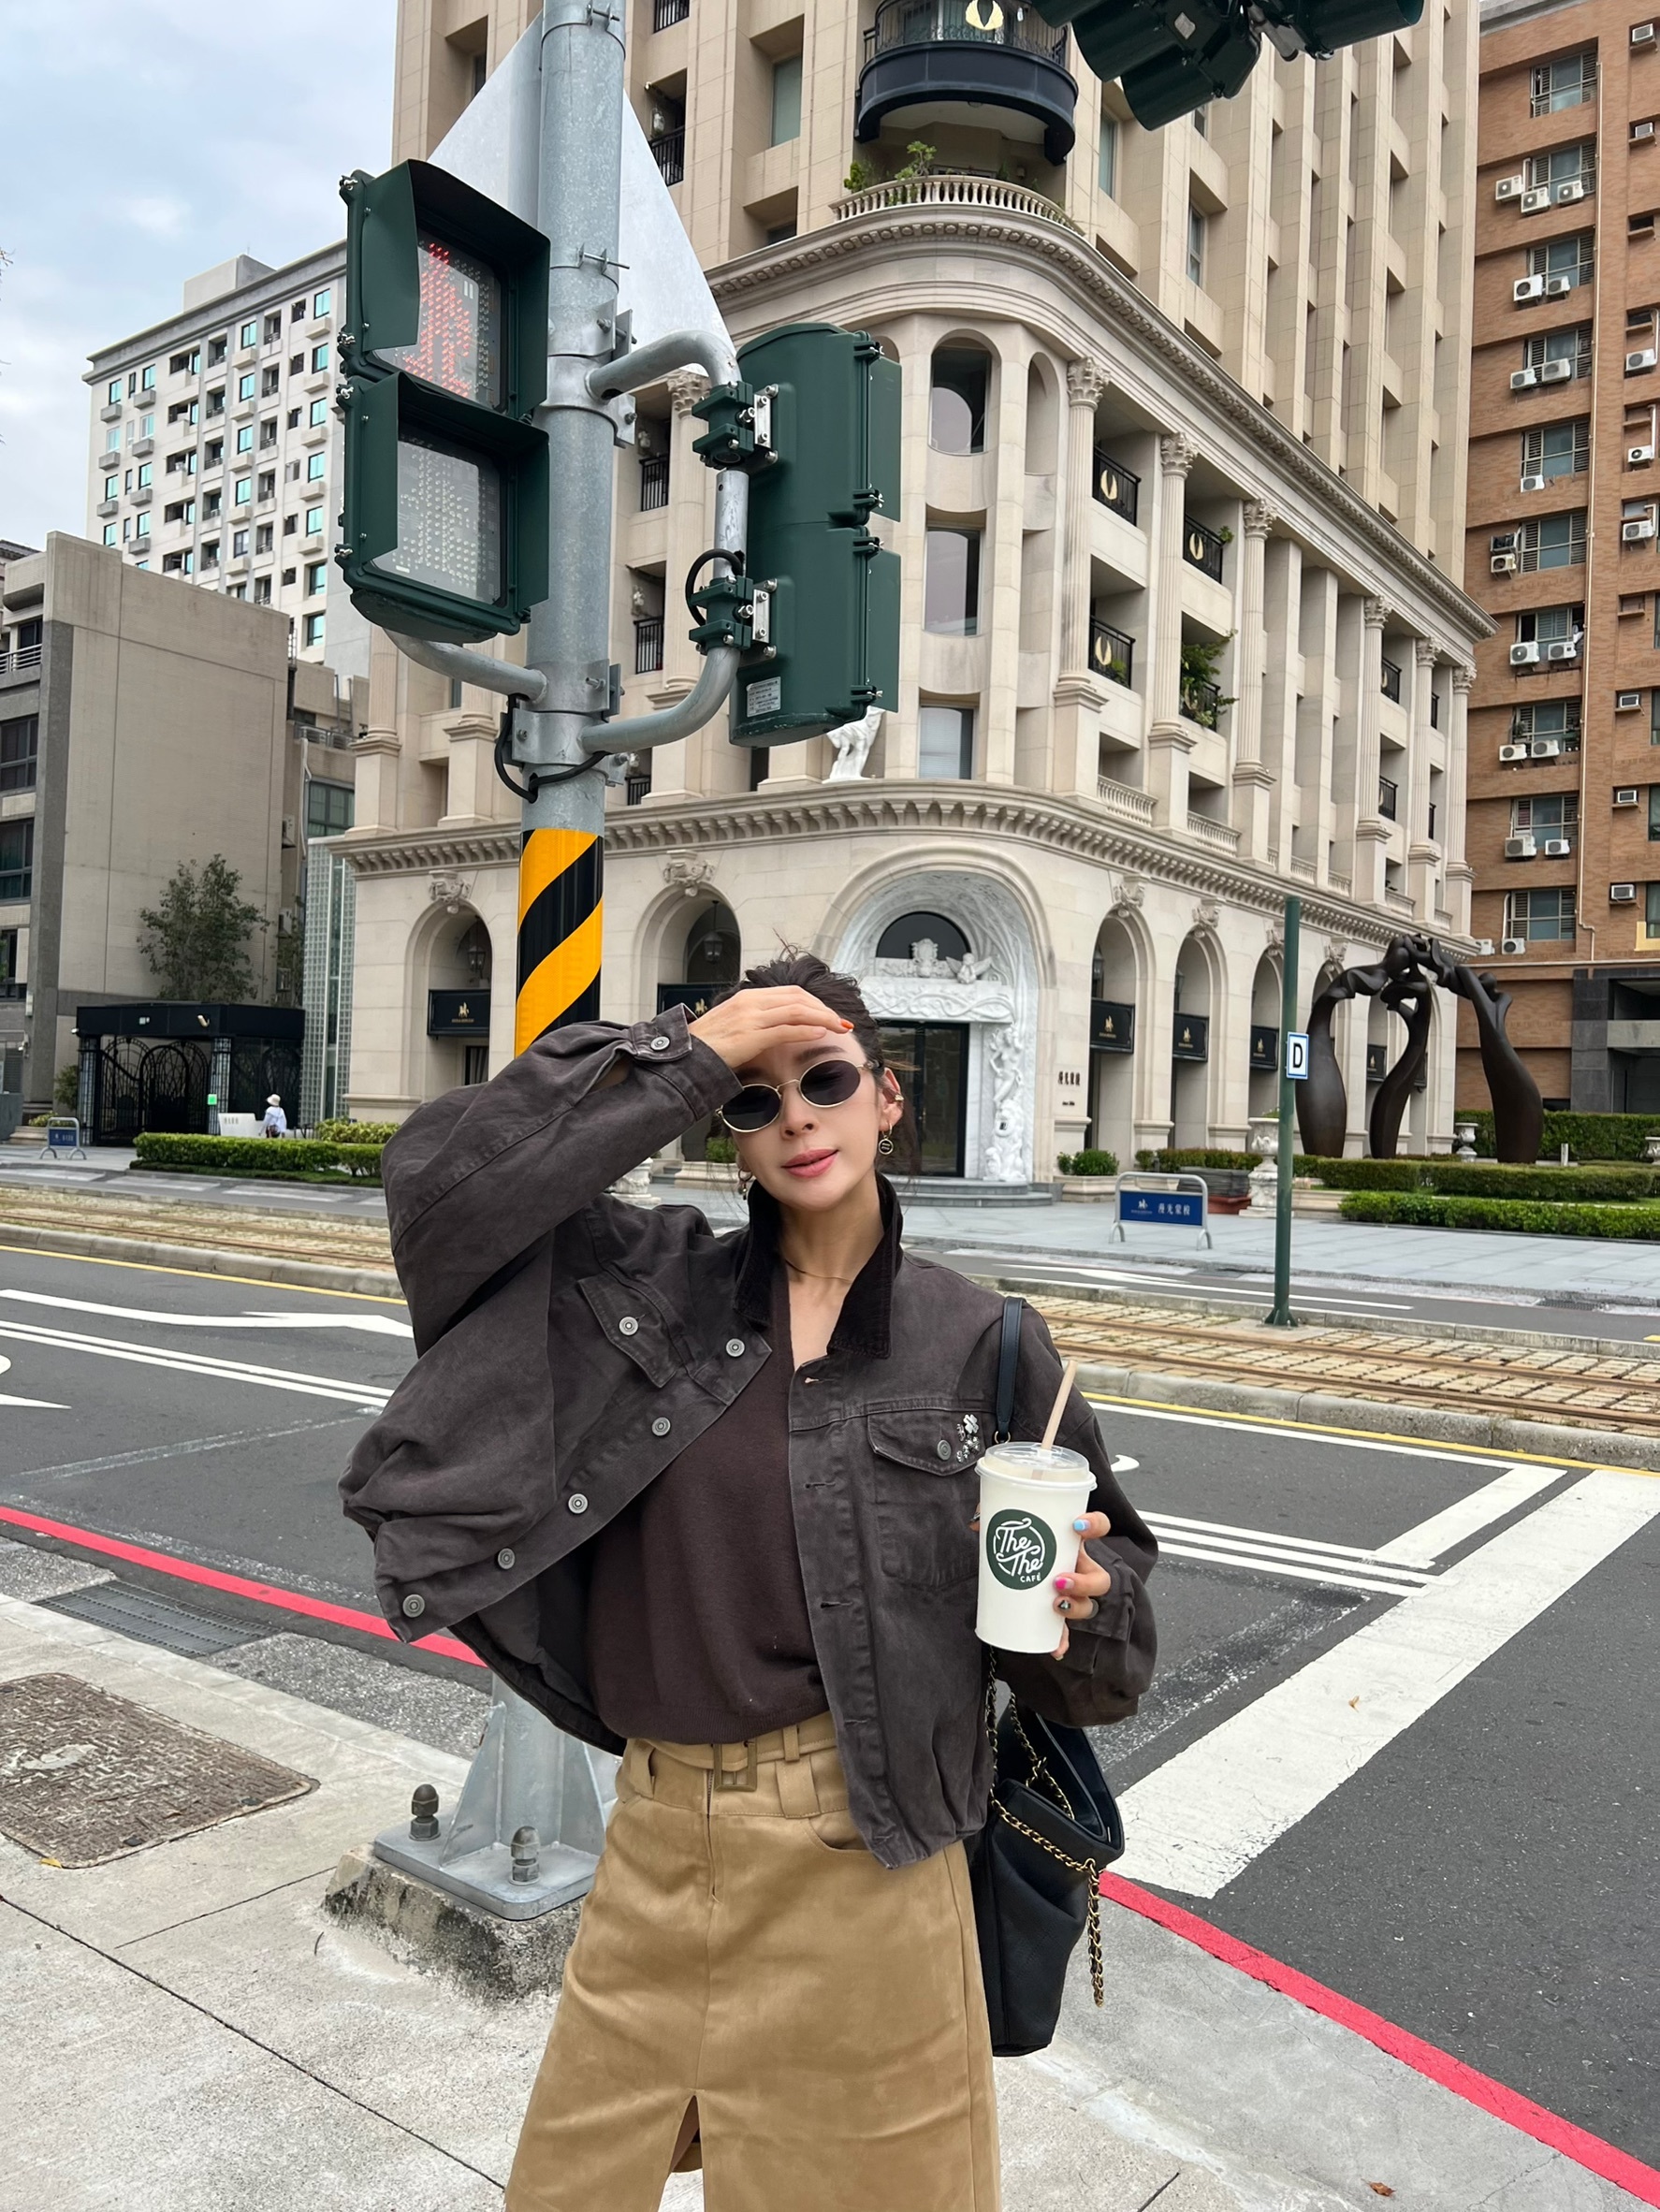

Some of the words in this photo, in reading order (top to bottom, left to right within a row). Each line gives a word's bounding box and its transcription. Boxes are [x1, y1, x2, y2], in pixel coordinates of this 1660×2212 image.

[1292, 1042, 1303, 1069] D
[995, 1517, 1032, 1554] The
[996, 1545, 1043, 1578] The
